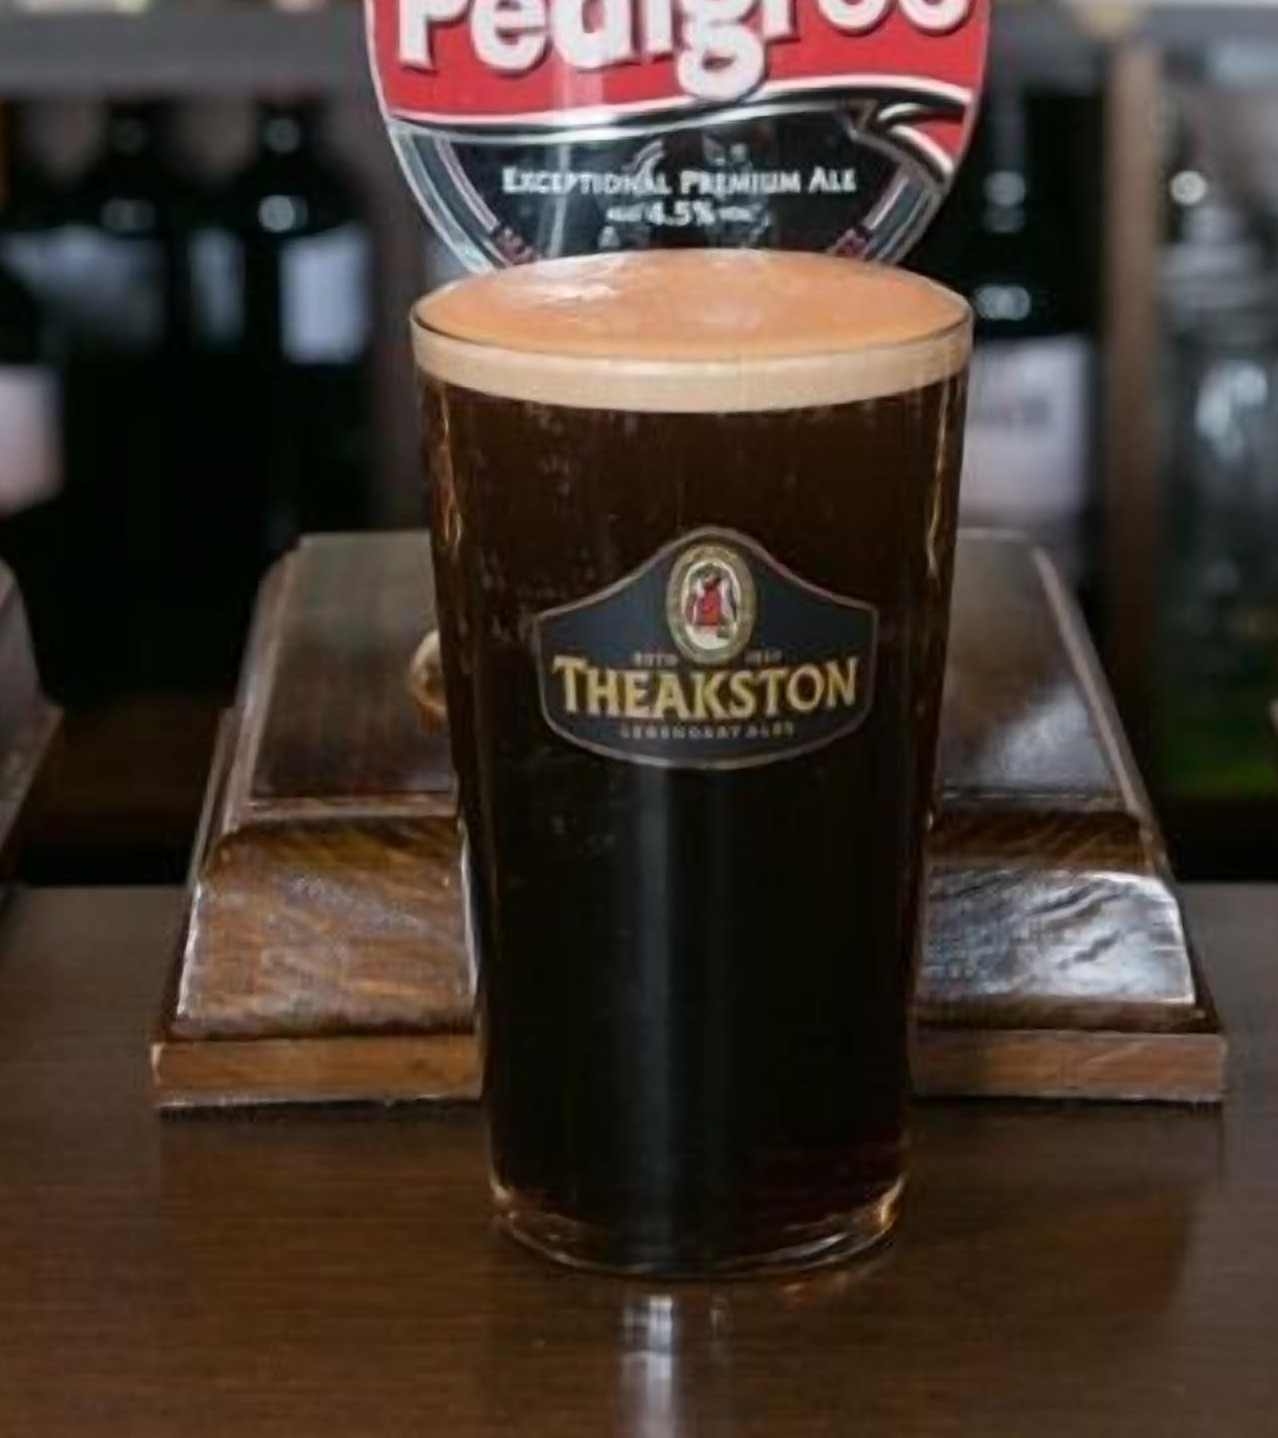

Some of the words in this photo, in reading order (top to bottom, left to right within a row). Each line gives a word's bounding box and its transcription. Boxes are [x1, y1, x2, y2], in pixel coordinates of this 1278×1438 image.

[501, 166, 672, 195] EXCEPTIONAL
[679, 167, 802, 195] PREMIUM
[808, 165, 858, 194] ALE
[551, 654, 859, 720] THEAKSTON
